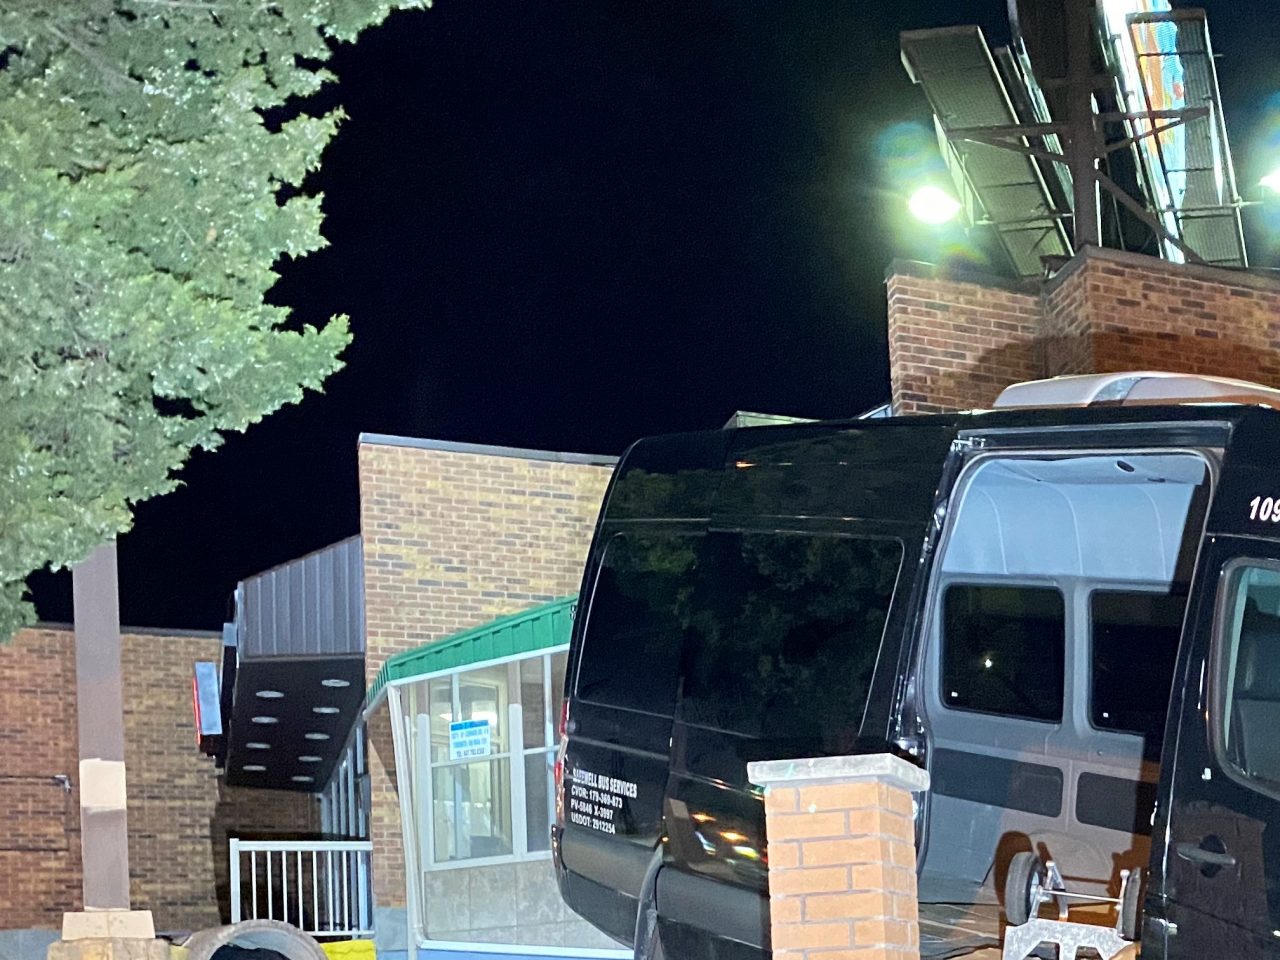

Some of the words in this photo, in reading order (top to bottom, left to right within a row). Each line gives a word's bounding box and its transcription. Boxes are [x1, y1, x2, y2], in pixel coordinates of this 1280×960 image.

[597, 774, 610, 791] BUS
[609, 777, 638, 799] SERVICES
[570, 811, 592, 828] USDOT:
